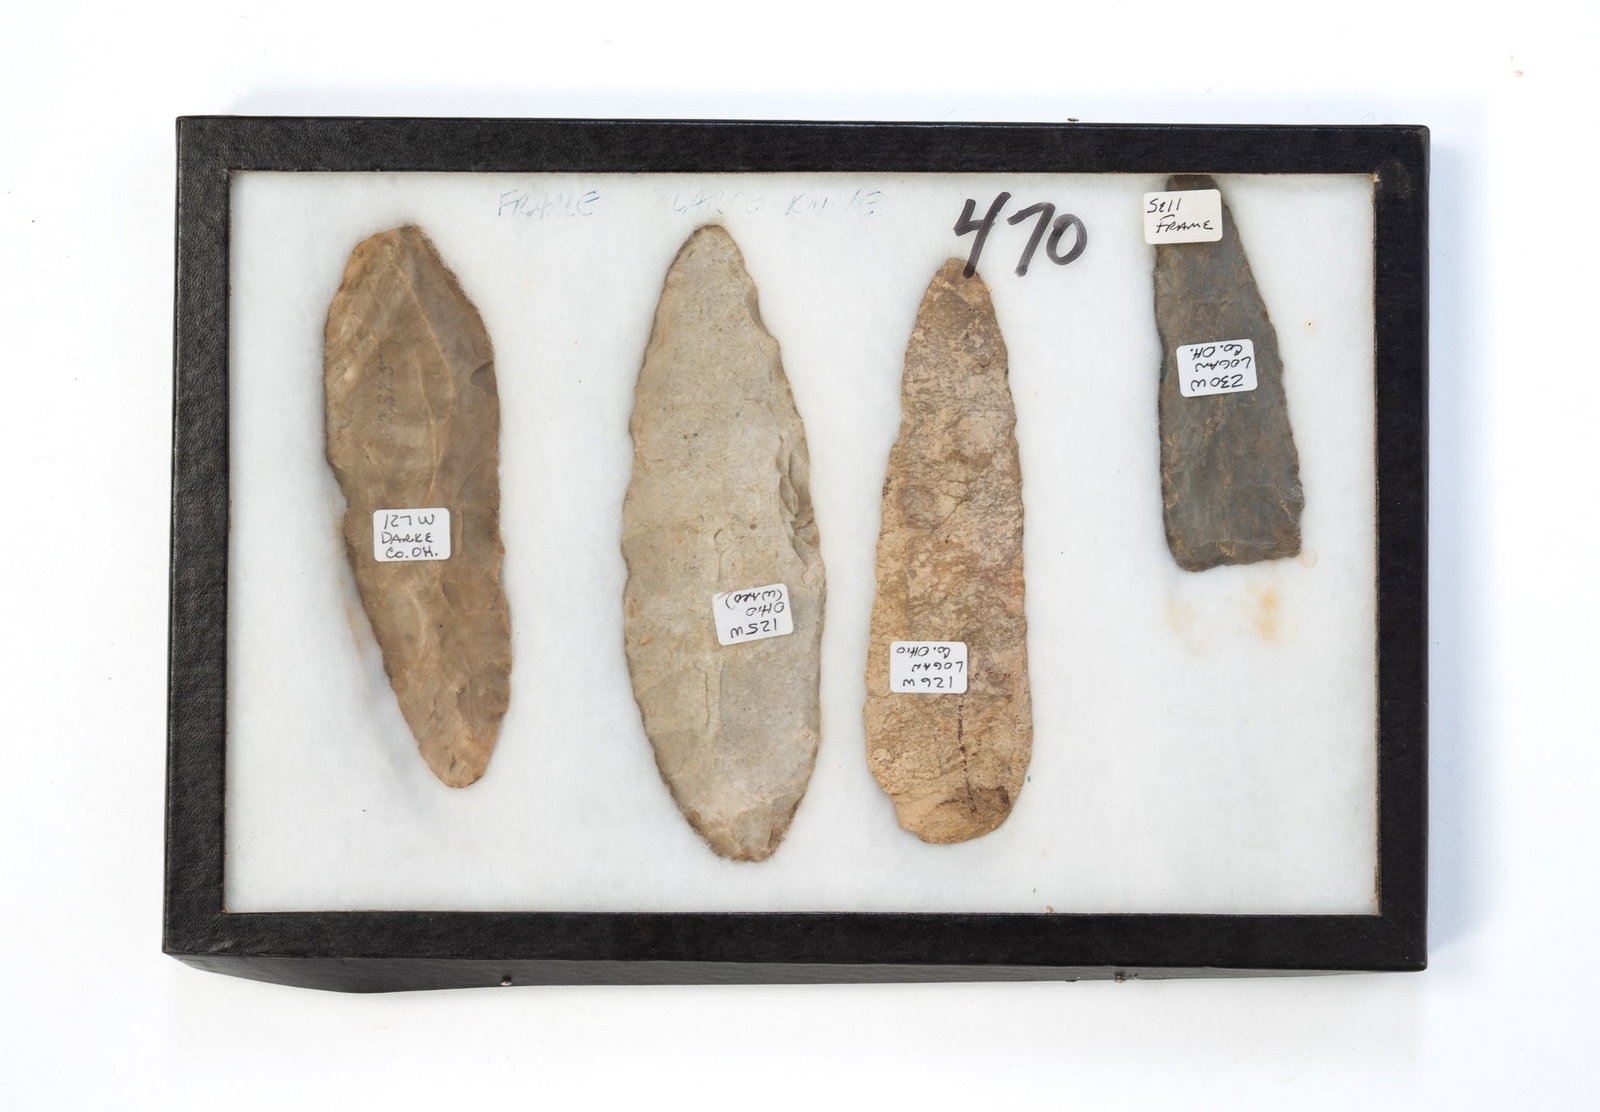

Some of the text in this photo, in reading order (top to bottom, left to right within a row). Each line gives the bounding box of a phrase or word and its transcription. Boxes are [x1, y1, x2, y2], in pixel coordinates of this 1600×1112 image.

[1155, 213, 1214, 234] FRAME
[953, 191, 1088, 279] 470
[1194, 356, 1252, 373] LOGAN
[380, 530, 434, 545] DARKE
[911, 660, 963, 673] LOGAN
